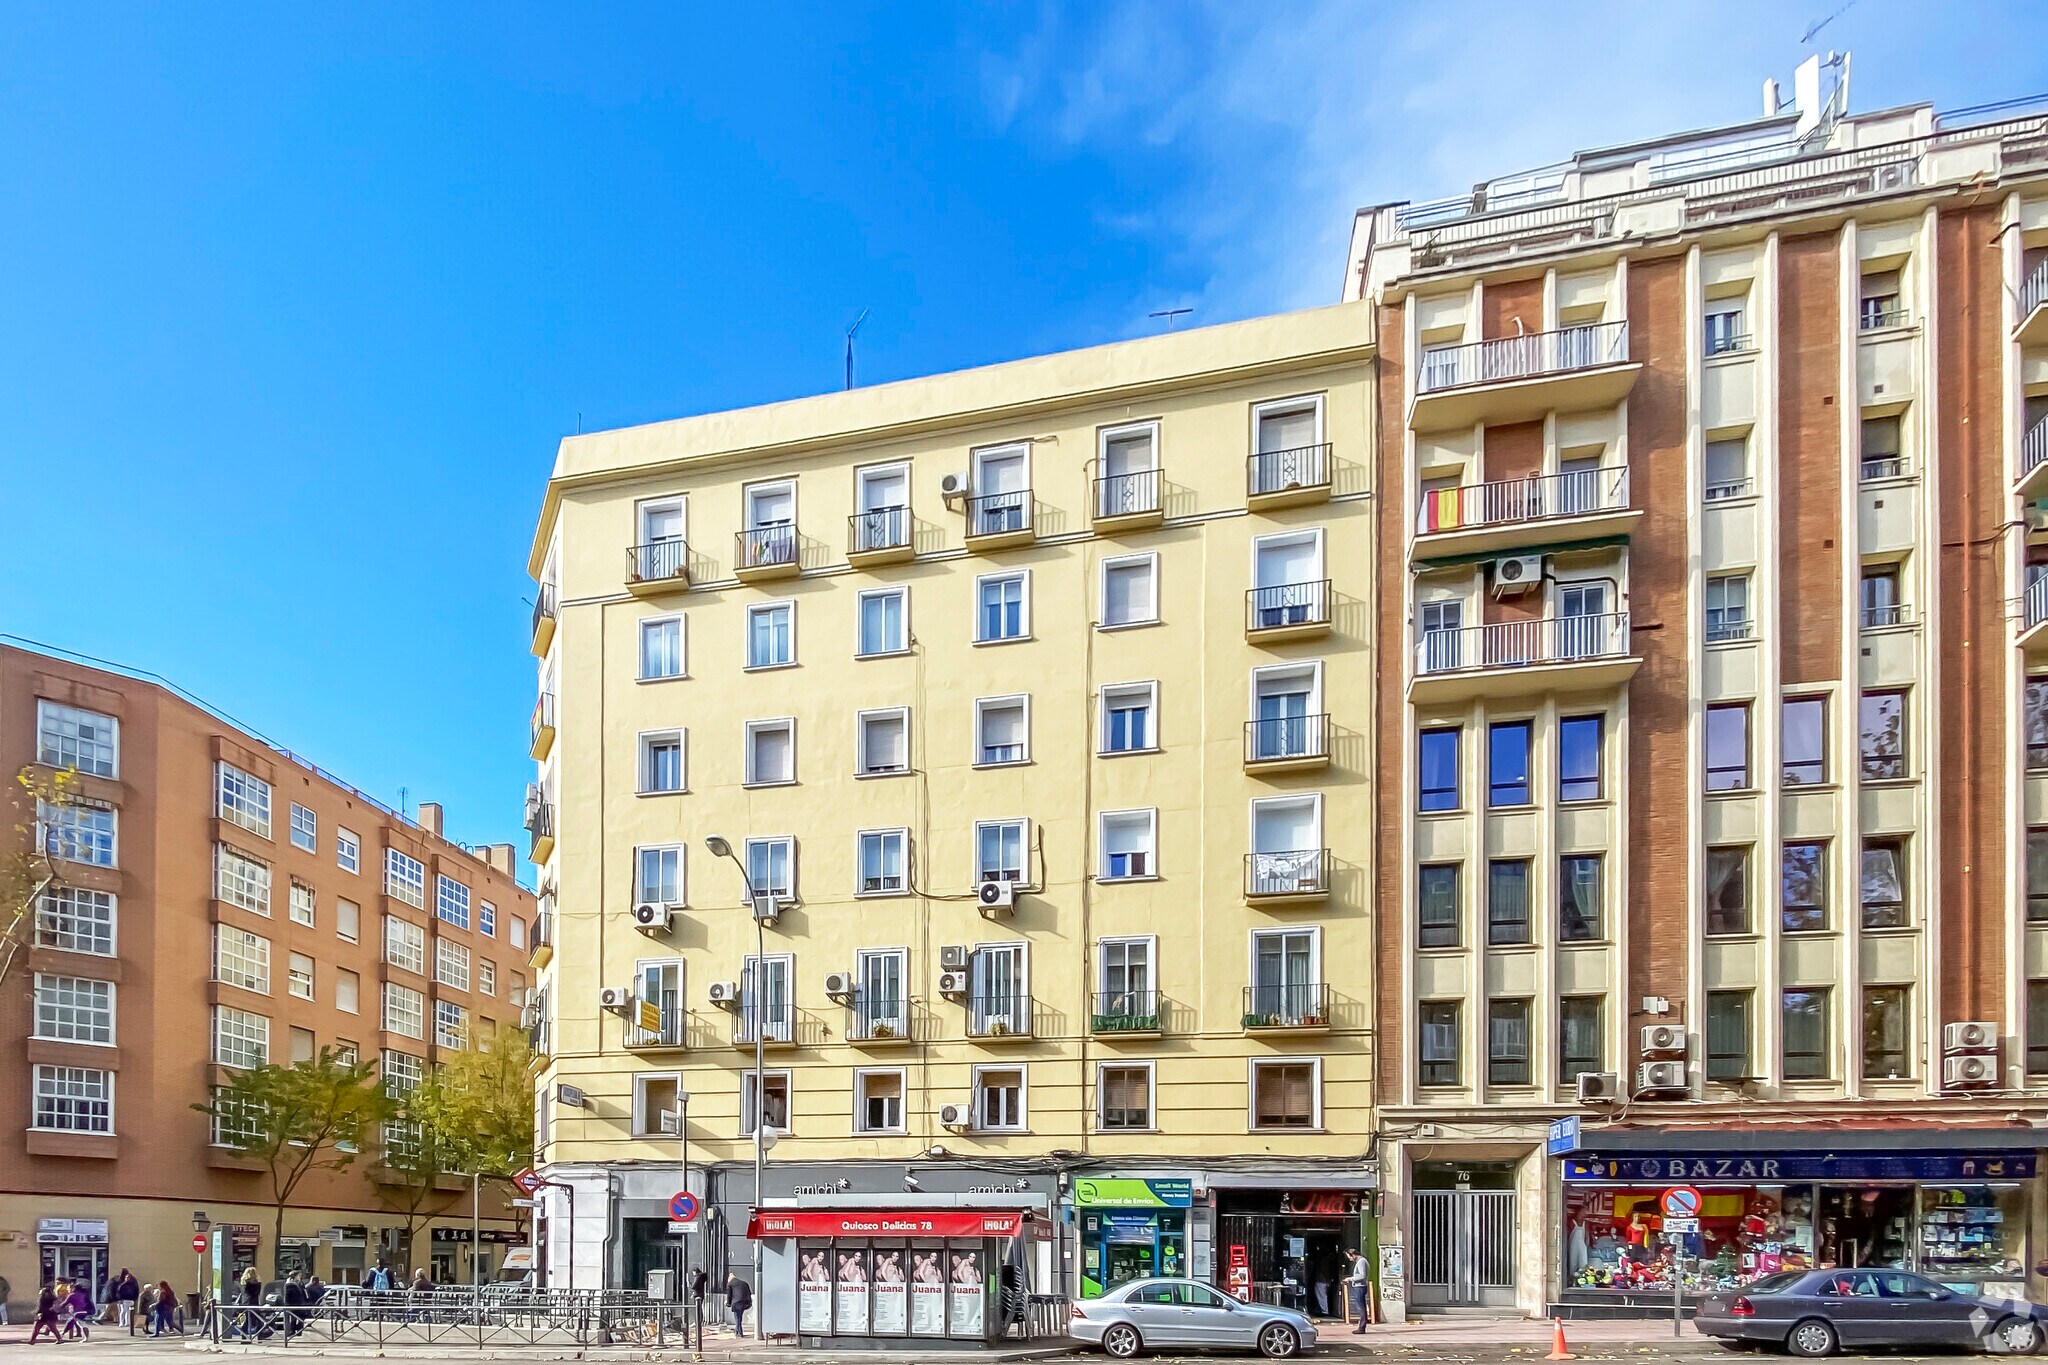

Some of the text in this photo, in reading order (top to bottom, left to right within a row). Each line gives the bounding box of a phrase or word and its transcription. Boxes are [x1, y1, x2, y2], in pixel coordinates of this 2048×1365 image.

[1668, 1159, 1780, 1178] BAZAR
[1457, 1171, 1470, 1181] 76
[793, 1182, 838, 1195] amichi
[968, 1183, 1015, 1194] amichi
[841, 1221, 933, 1230] Quiosco Delicias 78
[800, 1284, 829, 1292] Juana
[837, 1284, 866, 1293] Juana
[875, 1284, 904, 1293] Juana
[912, 1285, 942, 1294] Juana
[950, 1285, 980, 1295] Juana
